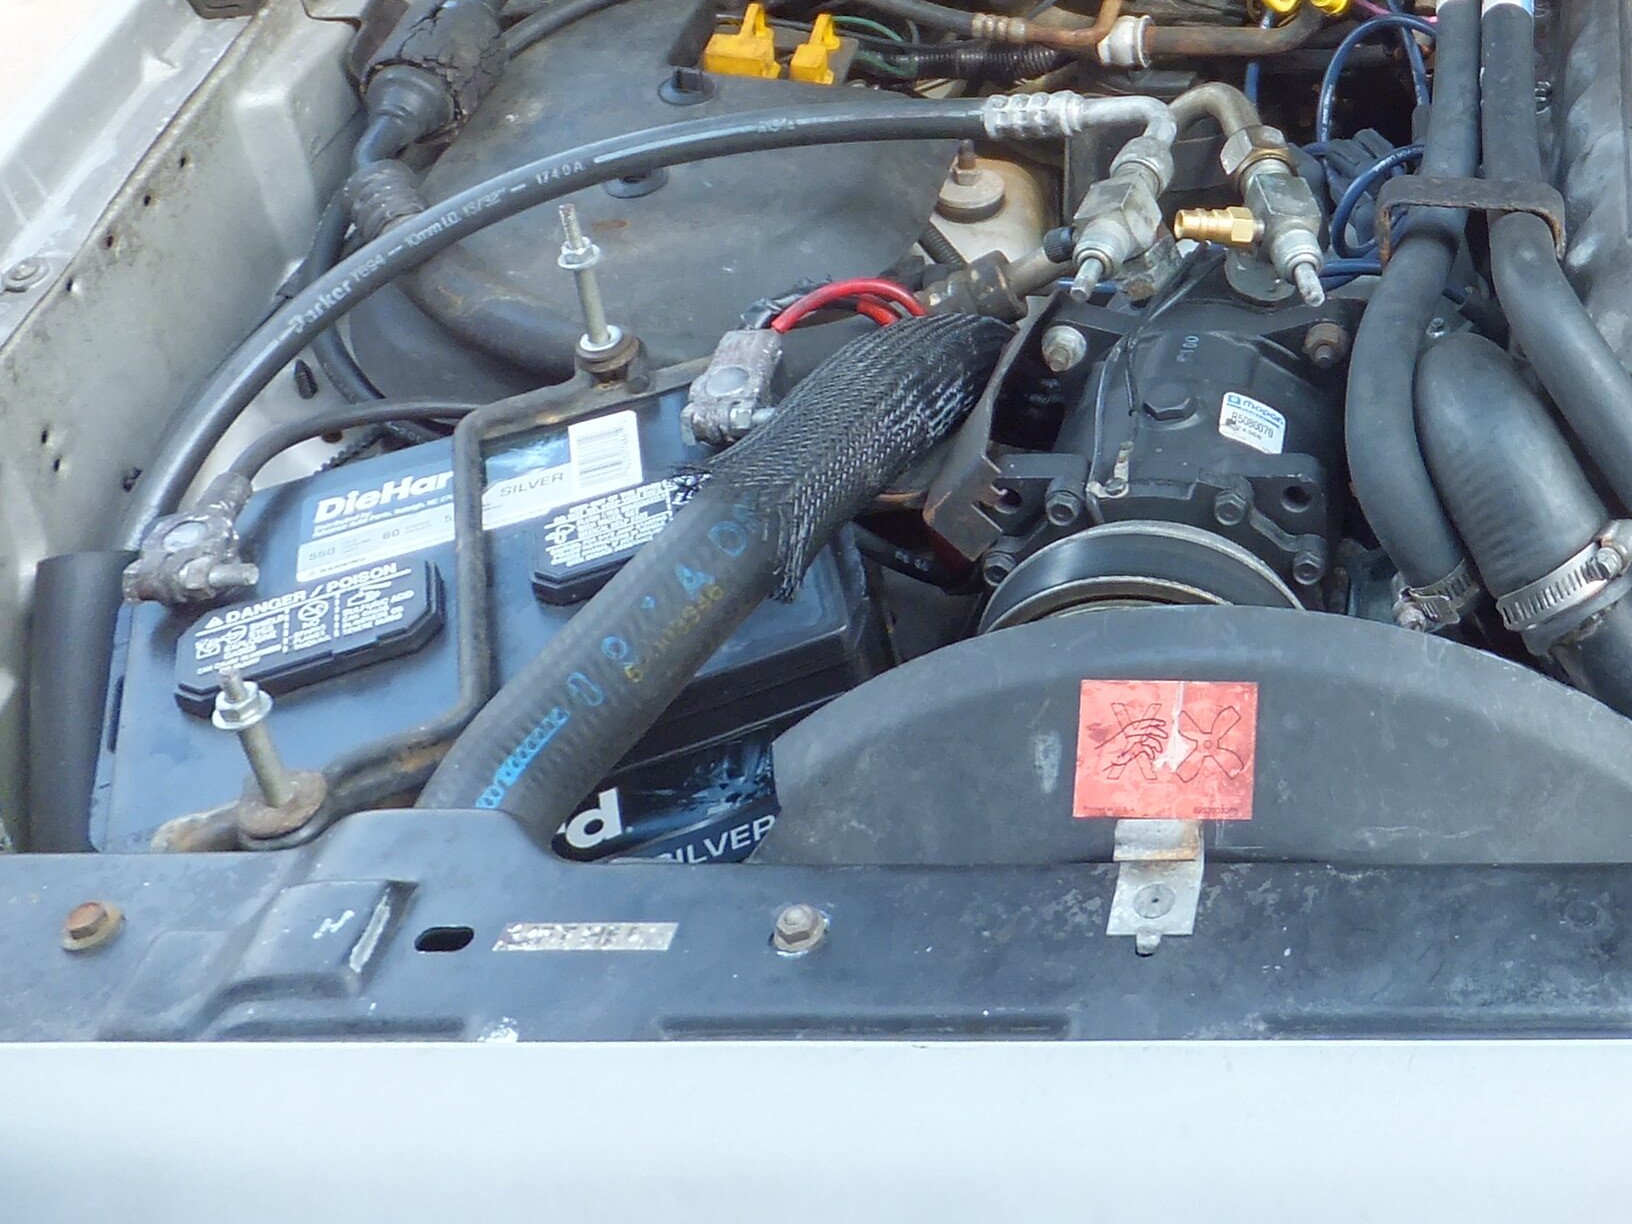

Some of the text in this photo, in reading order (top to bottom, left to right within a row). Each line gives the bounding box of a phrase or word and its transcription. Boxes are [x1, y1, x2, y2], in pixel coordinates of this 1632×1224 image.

[290, 280, 352, 333] Parker
[314, 470, 455, 523] DieHar
[499, 471, 564, 497] SILVER
[225, 590, 307, 624] DANGER
[326, 563, 397, 593] POISON
